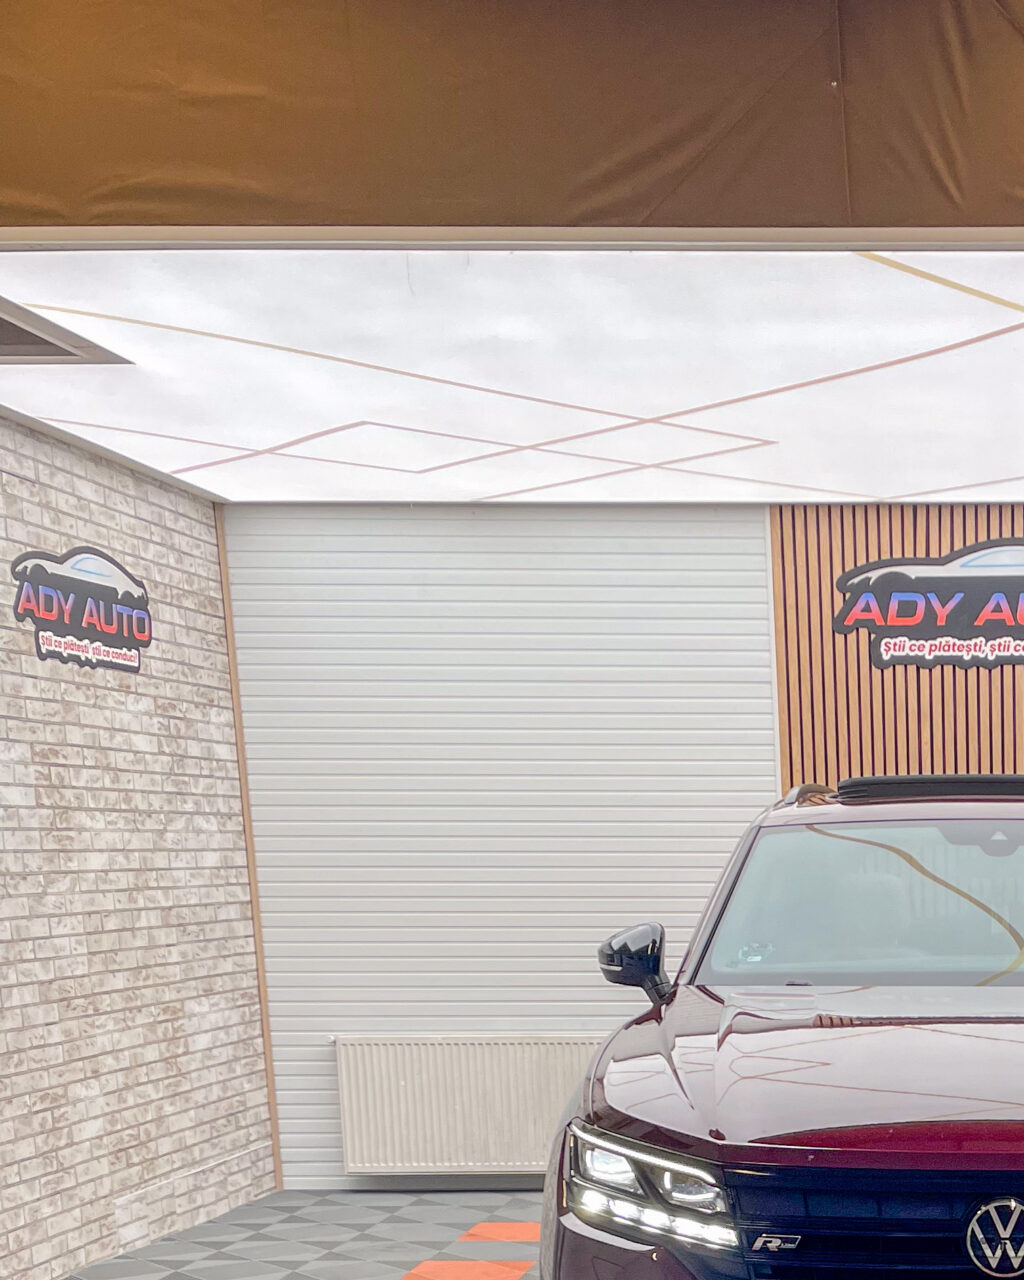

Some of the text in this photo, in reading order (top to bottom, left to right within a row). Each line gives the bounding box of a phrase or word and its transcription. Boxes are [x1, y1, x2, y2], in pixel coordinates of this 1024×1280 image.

[18, 581, 150, 641] ADY AUTO
[843, 592, 965, 626] ADY
[883, 640, 906, 656] Știi
[908, 643, 926, 653] ce
[989, 641, 1011, 656] știi
